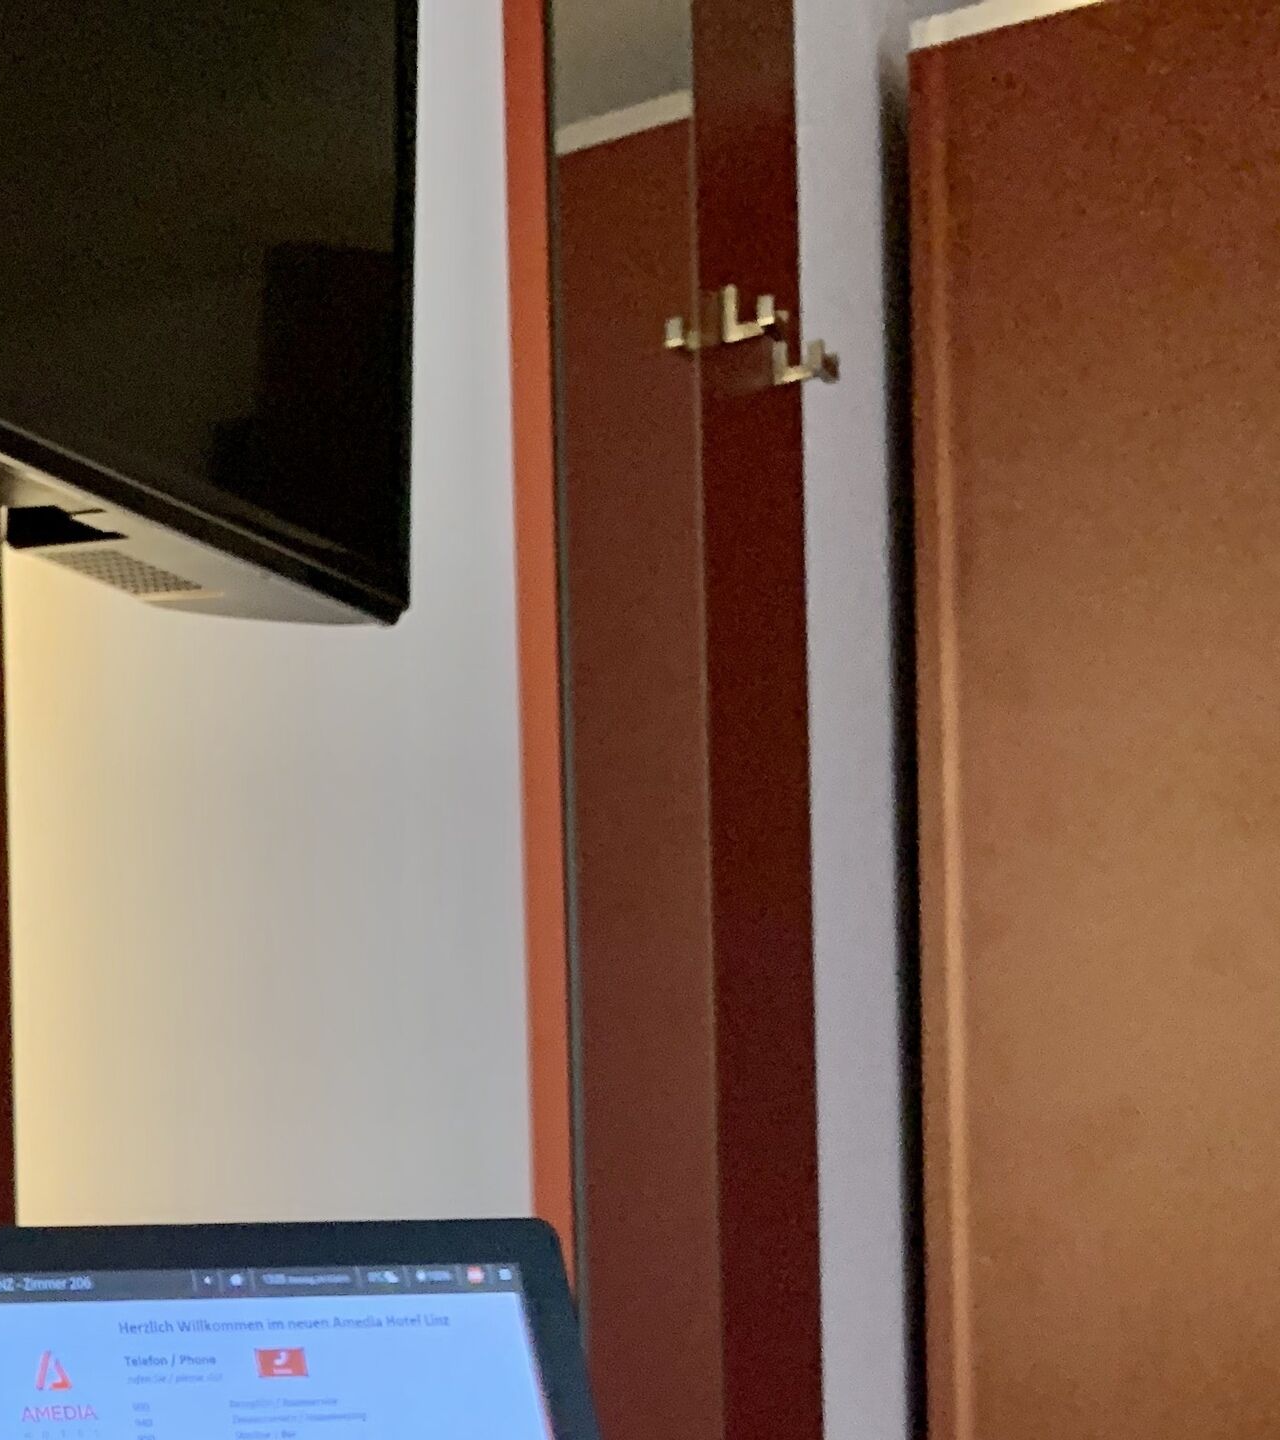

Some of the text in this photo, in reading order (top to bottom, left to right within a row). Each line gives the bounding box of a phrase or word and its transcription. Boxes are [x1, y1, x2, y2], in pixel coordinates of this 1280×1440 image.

[23, 1276, 68, 1291] Zimmer
[118, 1313, 450, 1335] Herzlich Willkommen im neuen Amedia Hotel Linz
[124, 1355, 168, 1367] Telefon
[179, 1354, 216, 1366] Phone
[21, 1404, 99, 1423] AMEDIA
